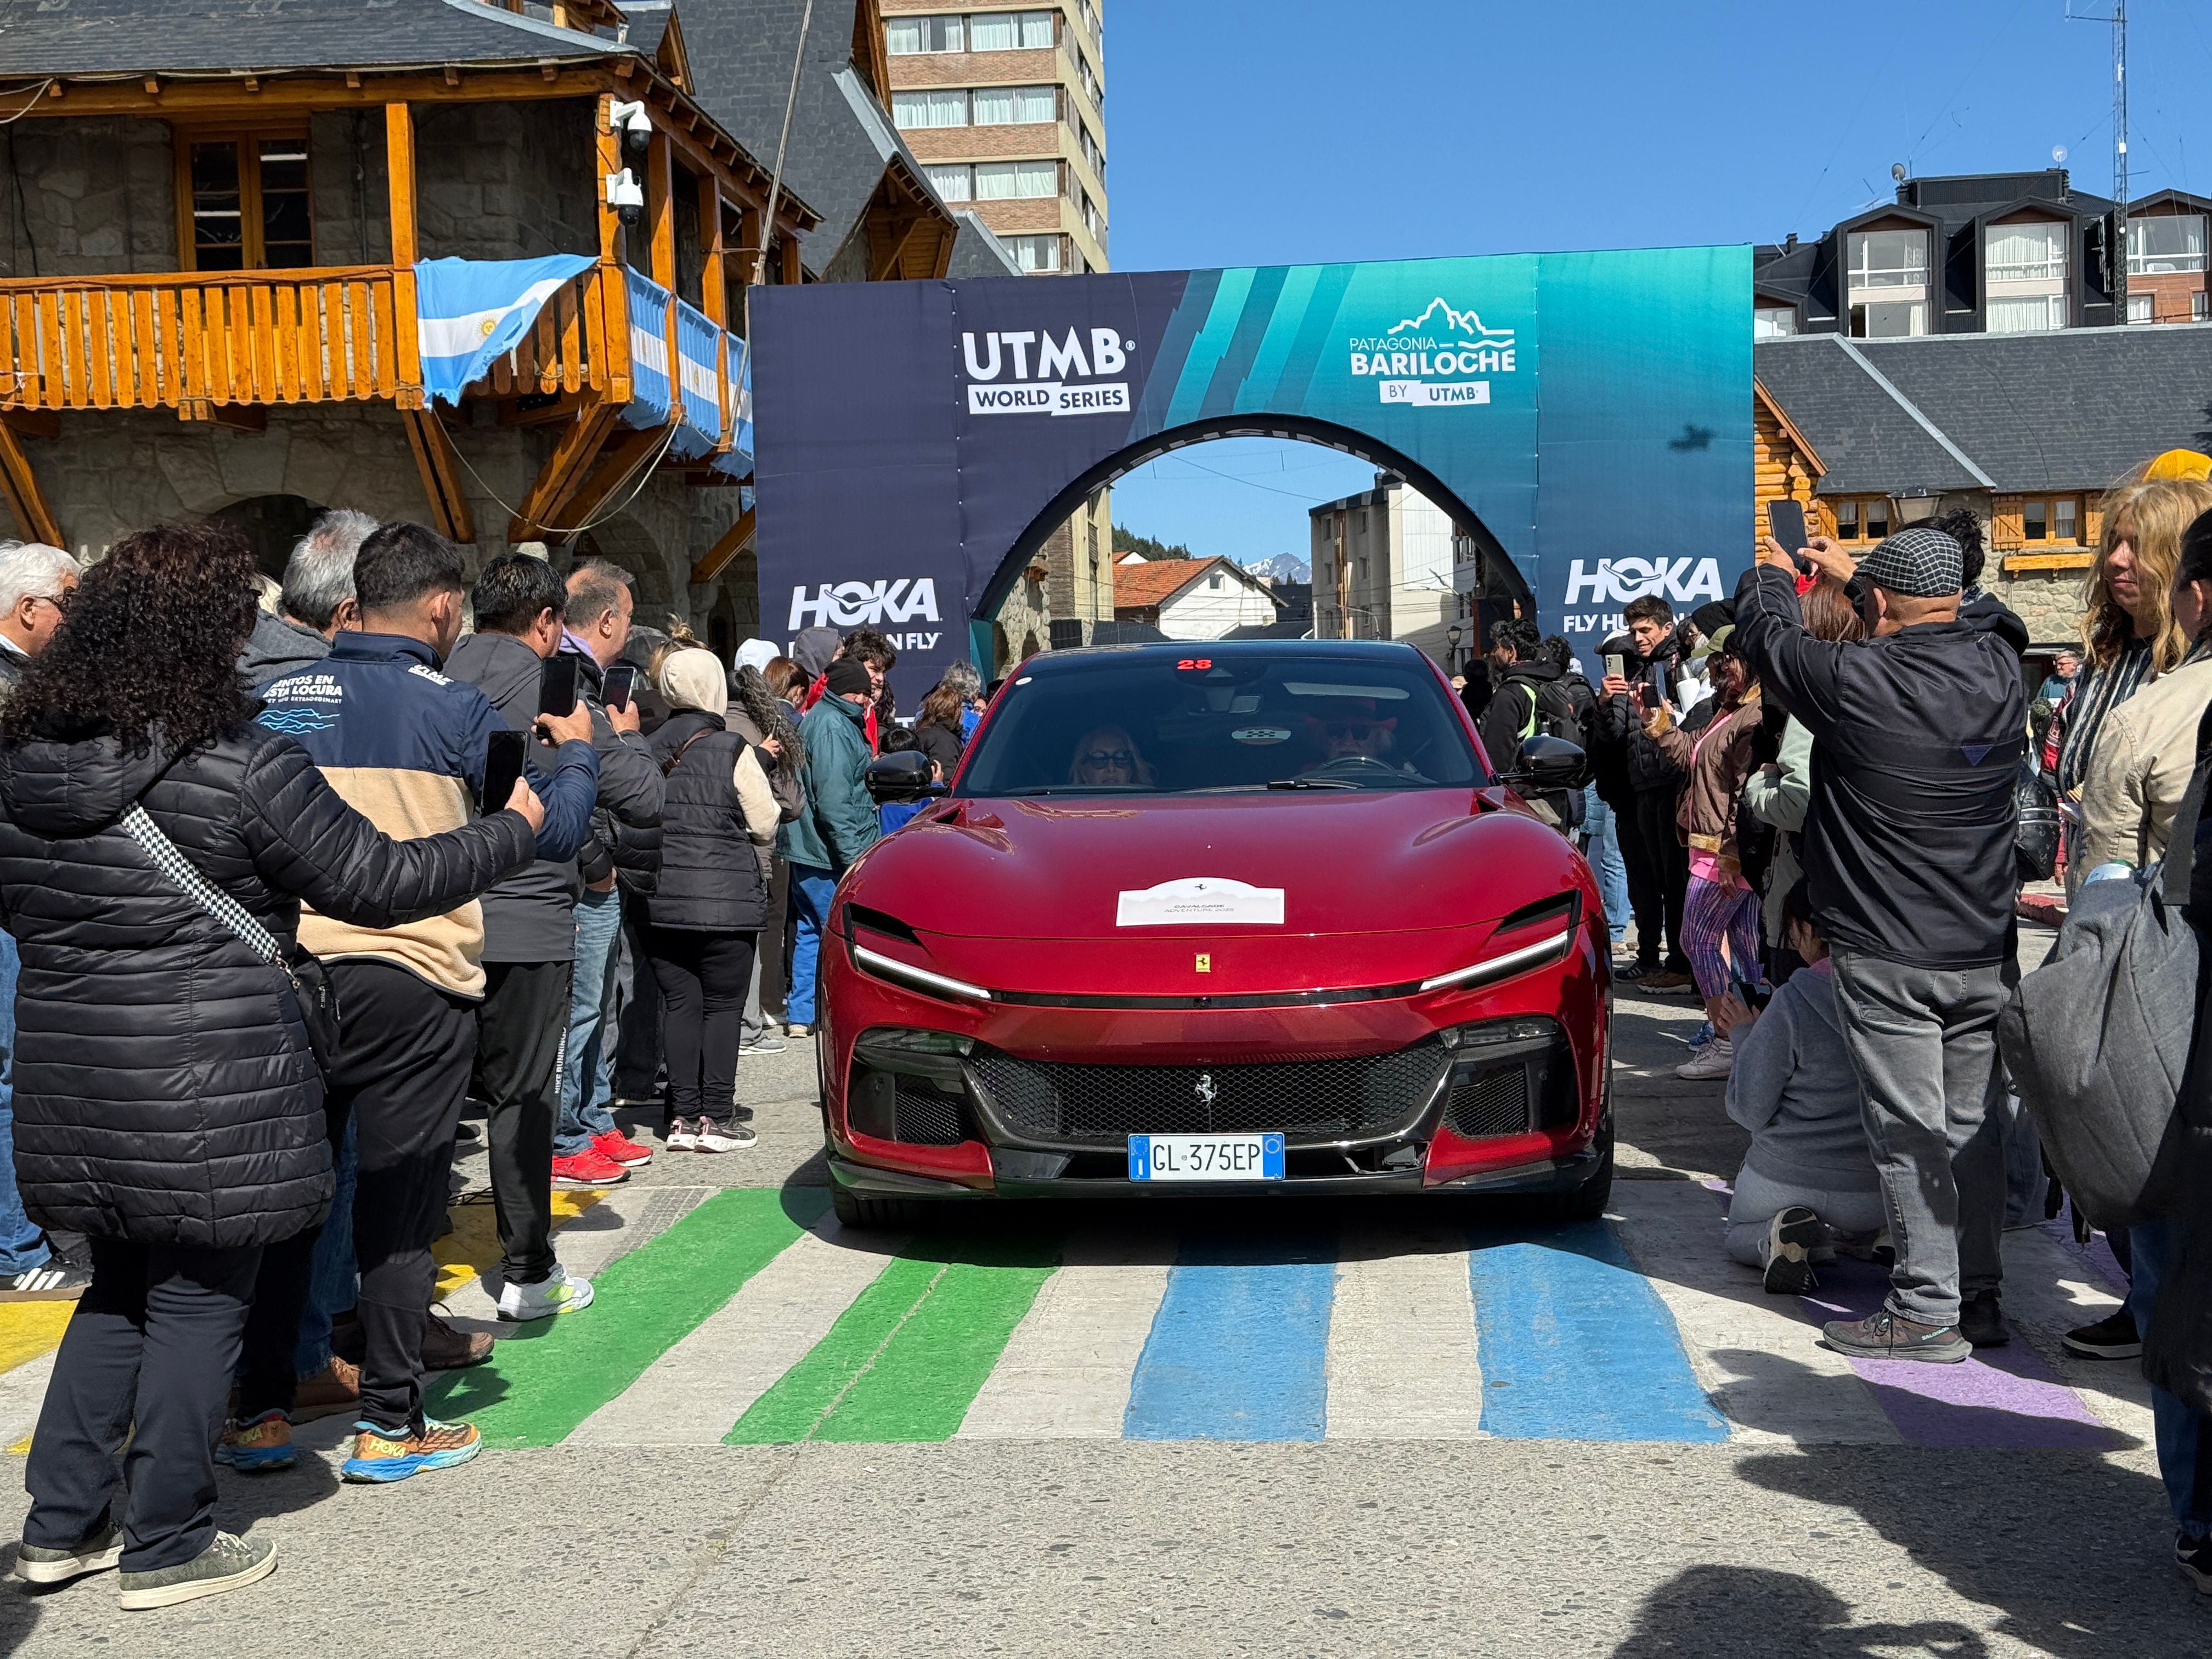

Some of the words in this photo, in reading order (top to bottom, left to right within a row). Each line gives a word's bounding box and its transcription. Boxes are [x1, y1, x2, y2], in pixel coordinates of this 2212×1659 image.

[1350, 337, 1437, 351] PATAGONIA
[1350, 349, 1516, 375] BARILOCHE
[975, 390, 1049, 407] WORLD
[1060, 390, 1123, 409] SERIES
[1389, 385, 1407, 397] BY
[1564, 557, 1724, 604] HOKA
[788, 578, 939, 630] HOKA
[1564, 614, 1599, 633] FLY
[315, 675, 334, 685] EN
[292, 685, 342, 696] LOCURA
[369, 1439, 407, 1459] HOKA
